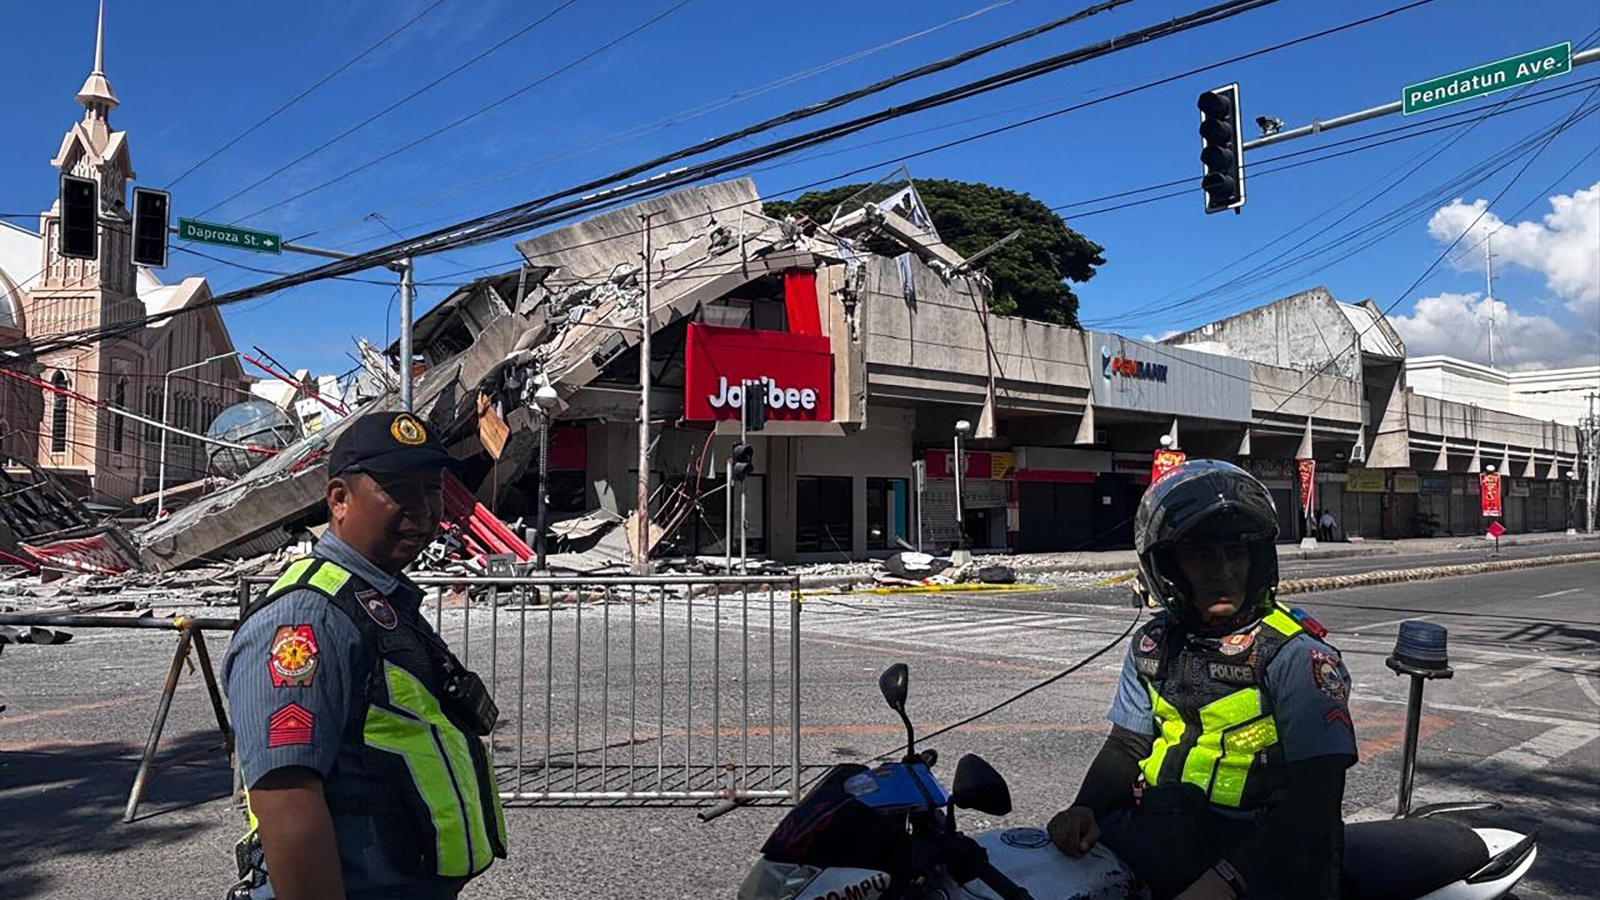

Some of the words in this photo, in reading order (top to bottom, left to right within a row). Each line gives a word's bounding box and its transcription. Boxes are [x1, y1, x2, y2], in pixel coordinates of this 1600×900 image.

[1411, 70, 1506, 106] Pendatun
[1515, 56, 1562, 78] Ave.
[187, 225, 239, 242] Daproza
[243, 234, 259, 246] St.
[1155, 452, 1182, 467] JOY
[1210, 664, 1252, 681] POLICE
